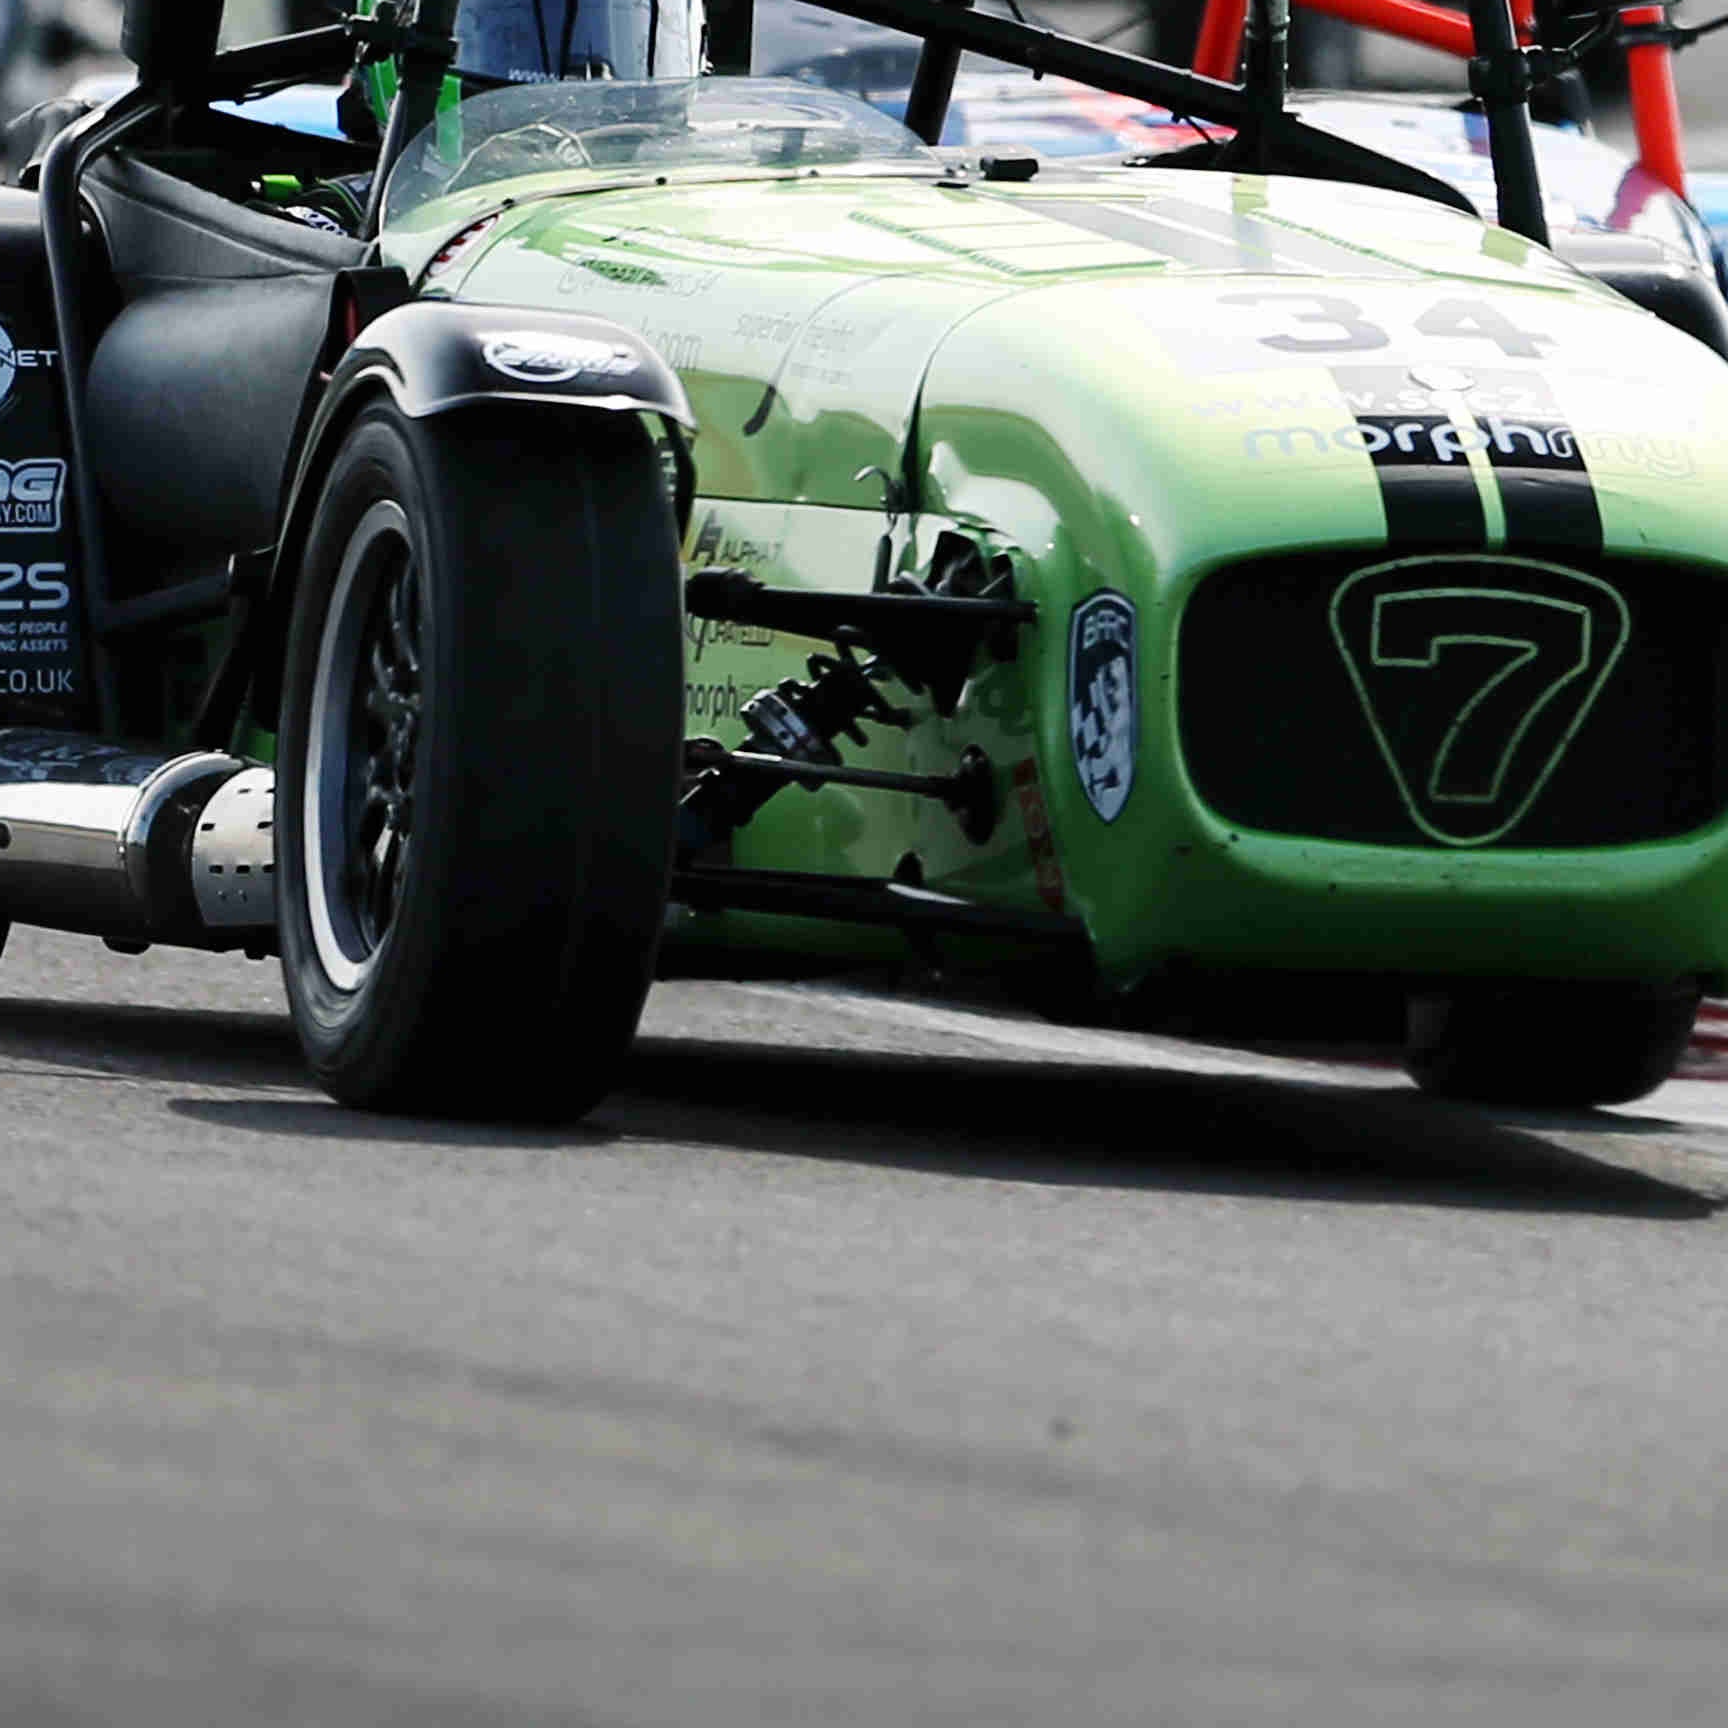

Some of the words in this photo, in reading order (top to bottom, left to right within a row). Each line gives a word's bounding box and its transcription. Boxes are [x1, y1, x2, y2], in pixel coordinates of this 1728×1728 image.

[1216, 291, 1560, 361] 34
[19, 620, 69, 635] PEOPLE
[19, 637, 69, 652] ASSETS
[1373, 587, 1591, 803] 7
